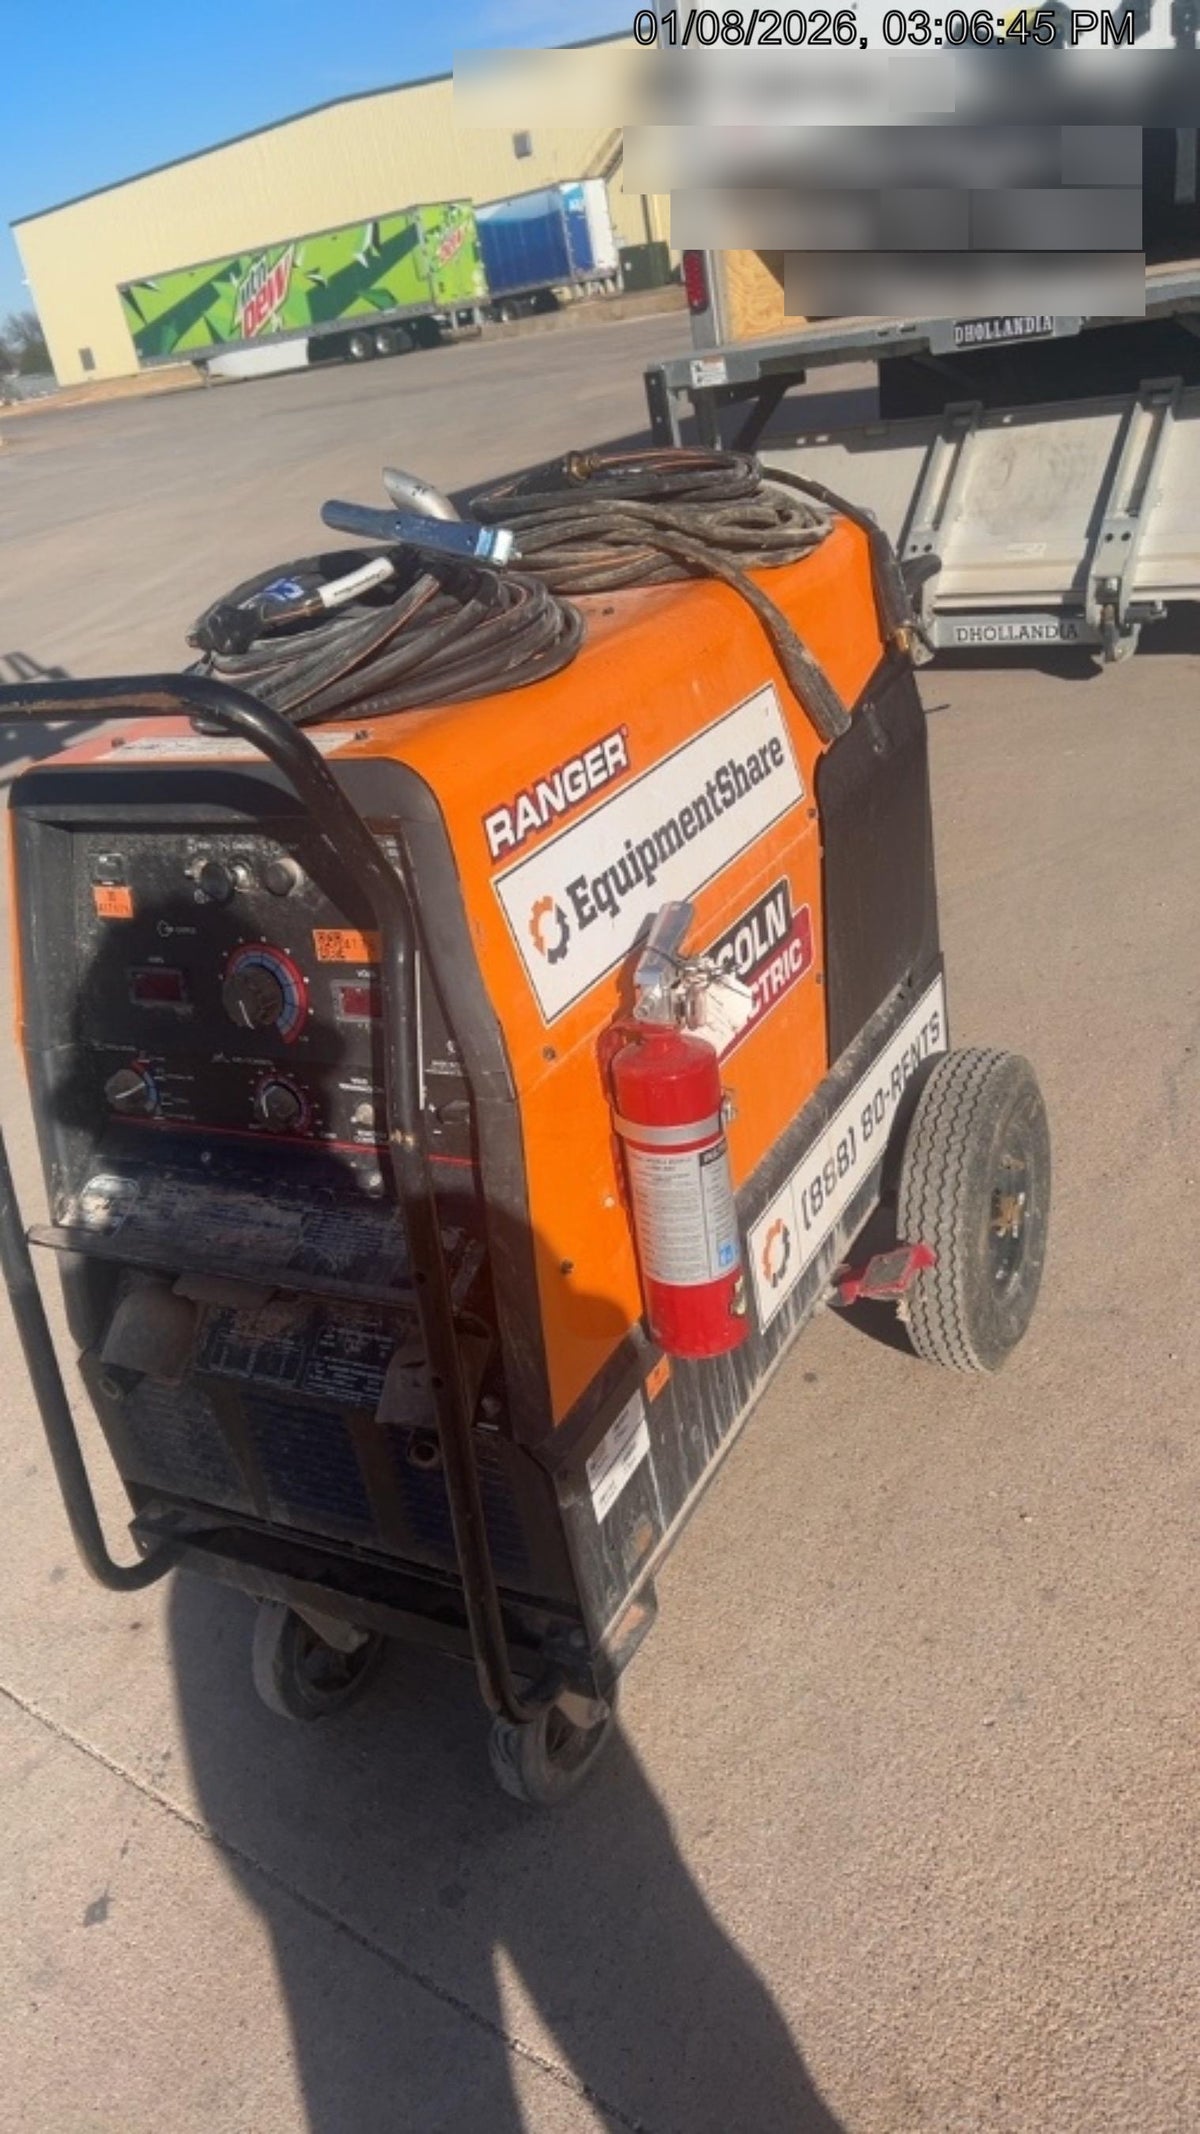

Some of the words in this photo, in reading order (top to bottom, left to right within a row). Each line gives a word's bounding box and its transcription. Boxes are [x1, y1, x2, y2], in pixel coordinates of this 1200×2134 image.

[954, 315, 1053, 344] DHOLLANDIA
[956, 623, 1079, 642] DHOLLANDIA
[484, 734, 629, 857] RANGER
[565, 736, 786, 930] EquipmentShare
[750, 938, 803, 1014] CTRIC
[801, 1125, 857, 1231] (888)
[862, 1010, 940, 1142] 80-RENTS
